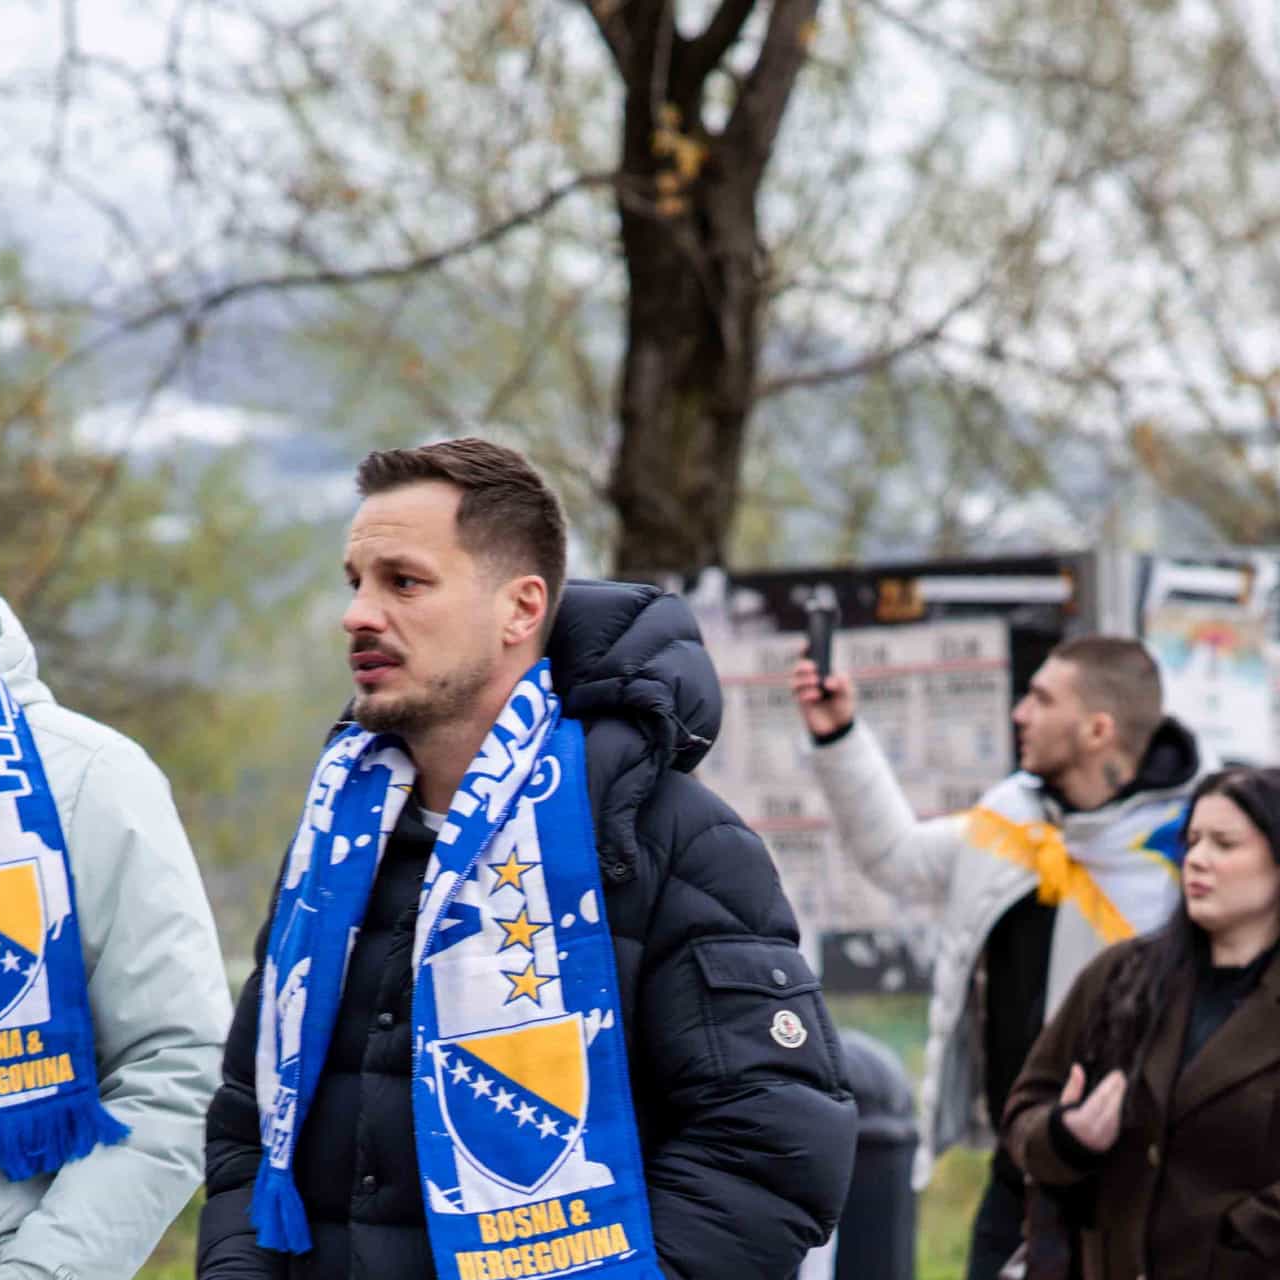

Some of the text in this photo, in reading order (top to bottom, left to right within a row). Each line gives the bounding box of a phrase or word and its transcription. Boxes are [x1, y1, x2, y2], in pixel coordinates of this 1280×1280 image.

[26, 1030, 44, 1054] &
[478, 1199, 591, 1244] BOSNA &
